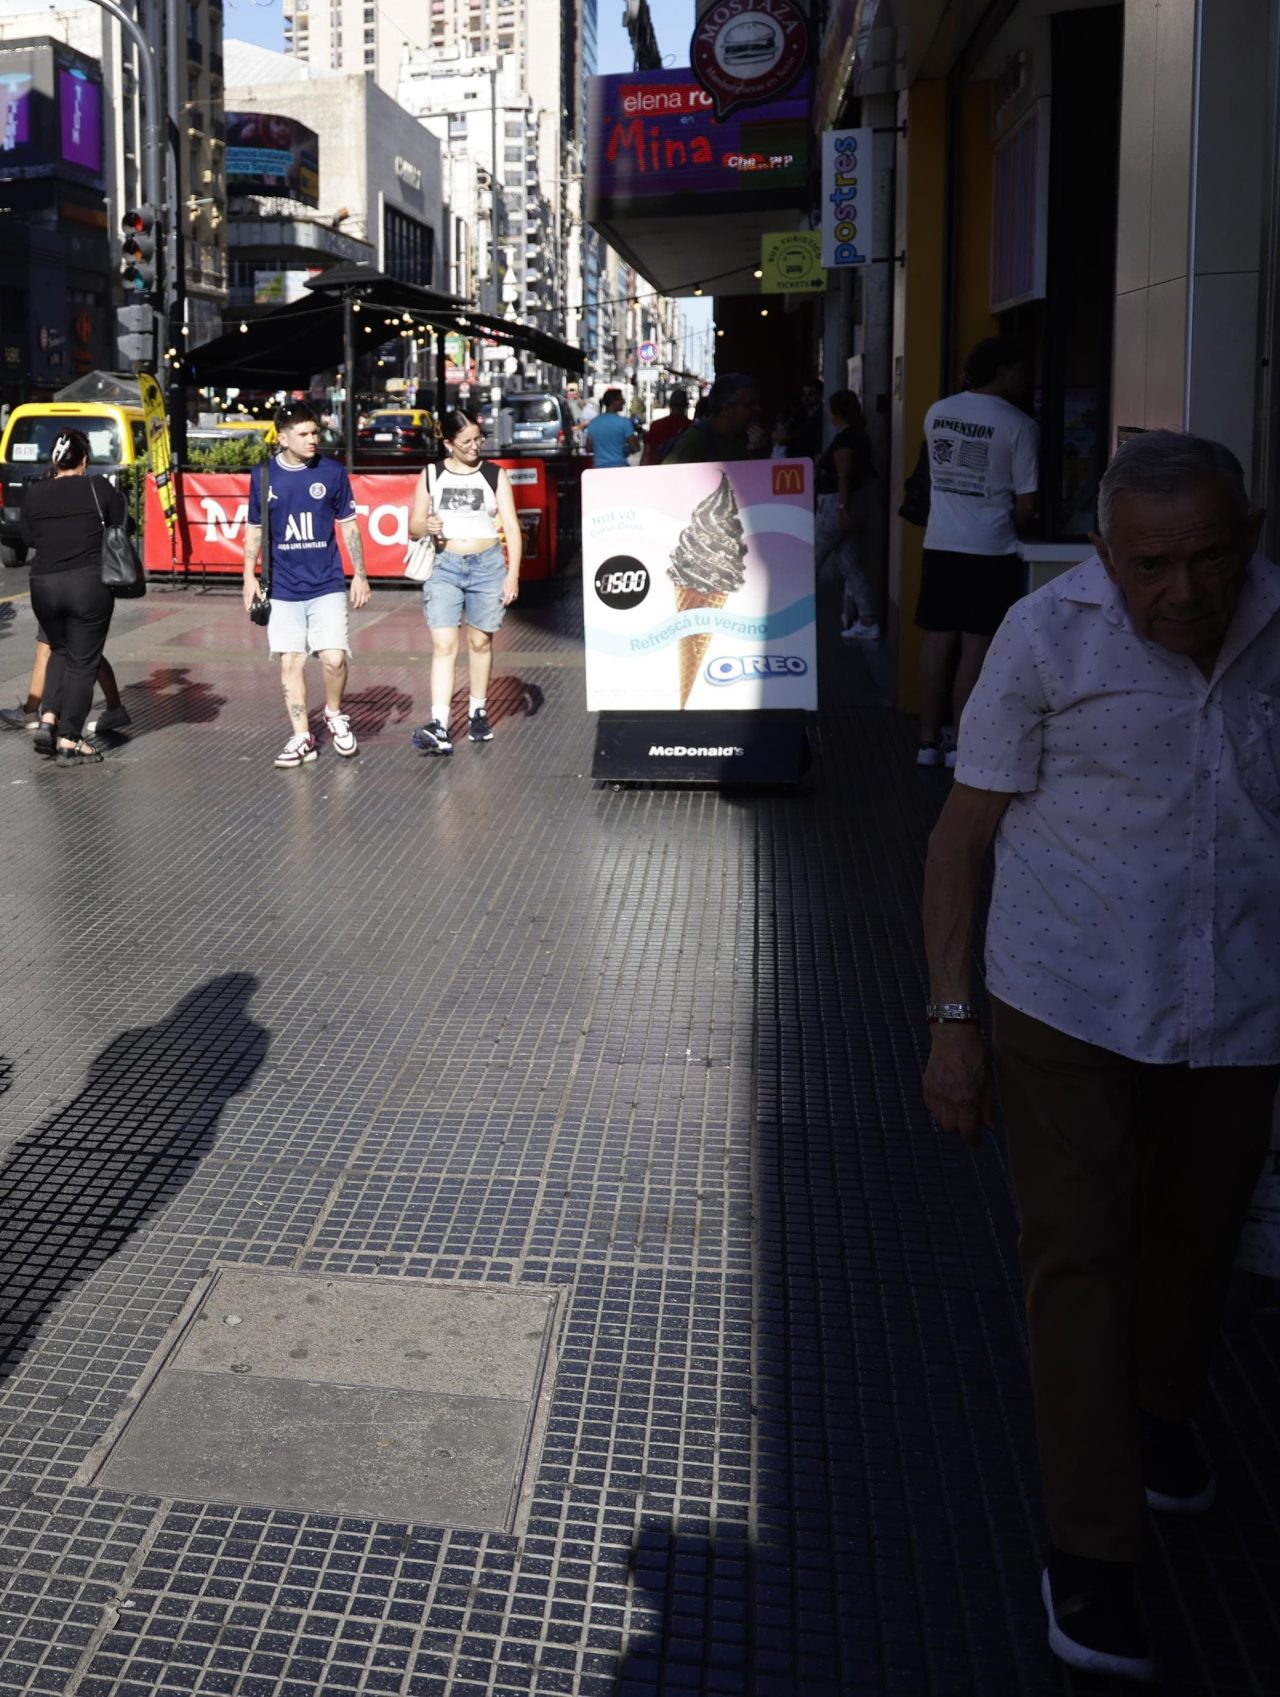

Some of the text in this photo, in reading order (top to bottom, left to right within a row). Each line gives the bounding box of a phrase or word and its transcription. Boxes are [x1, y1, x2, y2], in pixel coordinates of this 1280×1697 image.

[699, 0, 800, 43] MOSTAZA
[623, 91, 682, 112] elena
[679, 115, 695, 125] en
[829, 135, 866, 265] postres
[776, 280, 810, 290] TICKETS
[932, 418, 996, 440] DIMENSION
[284, 511, 314, 542] All
[591, 511, 636, 526] NUEVO
[630, 613, 769, 652] Refrescá tu verano
[707, 655, 808, 683] OREO
[648, 745, 745, 758] McDonald's
